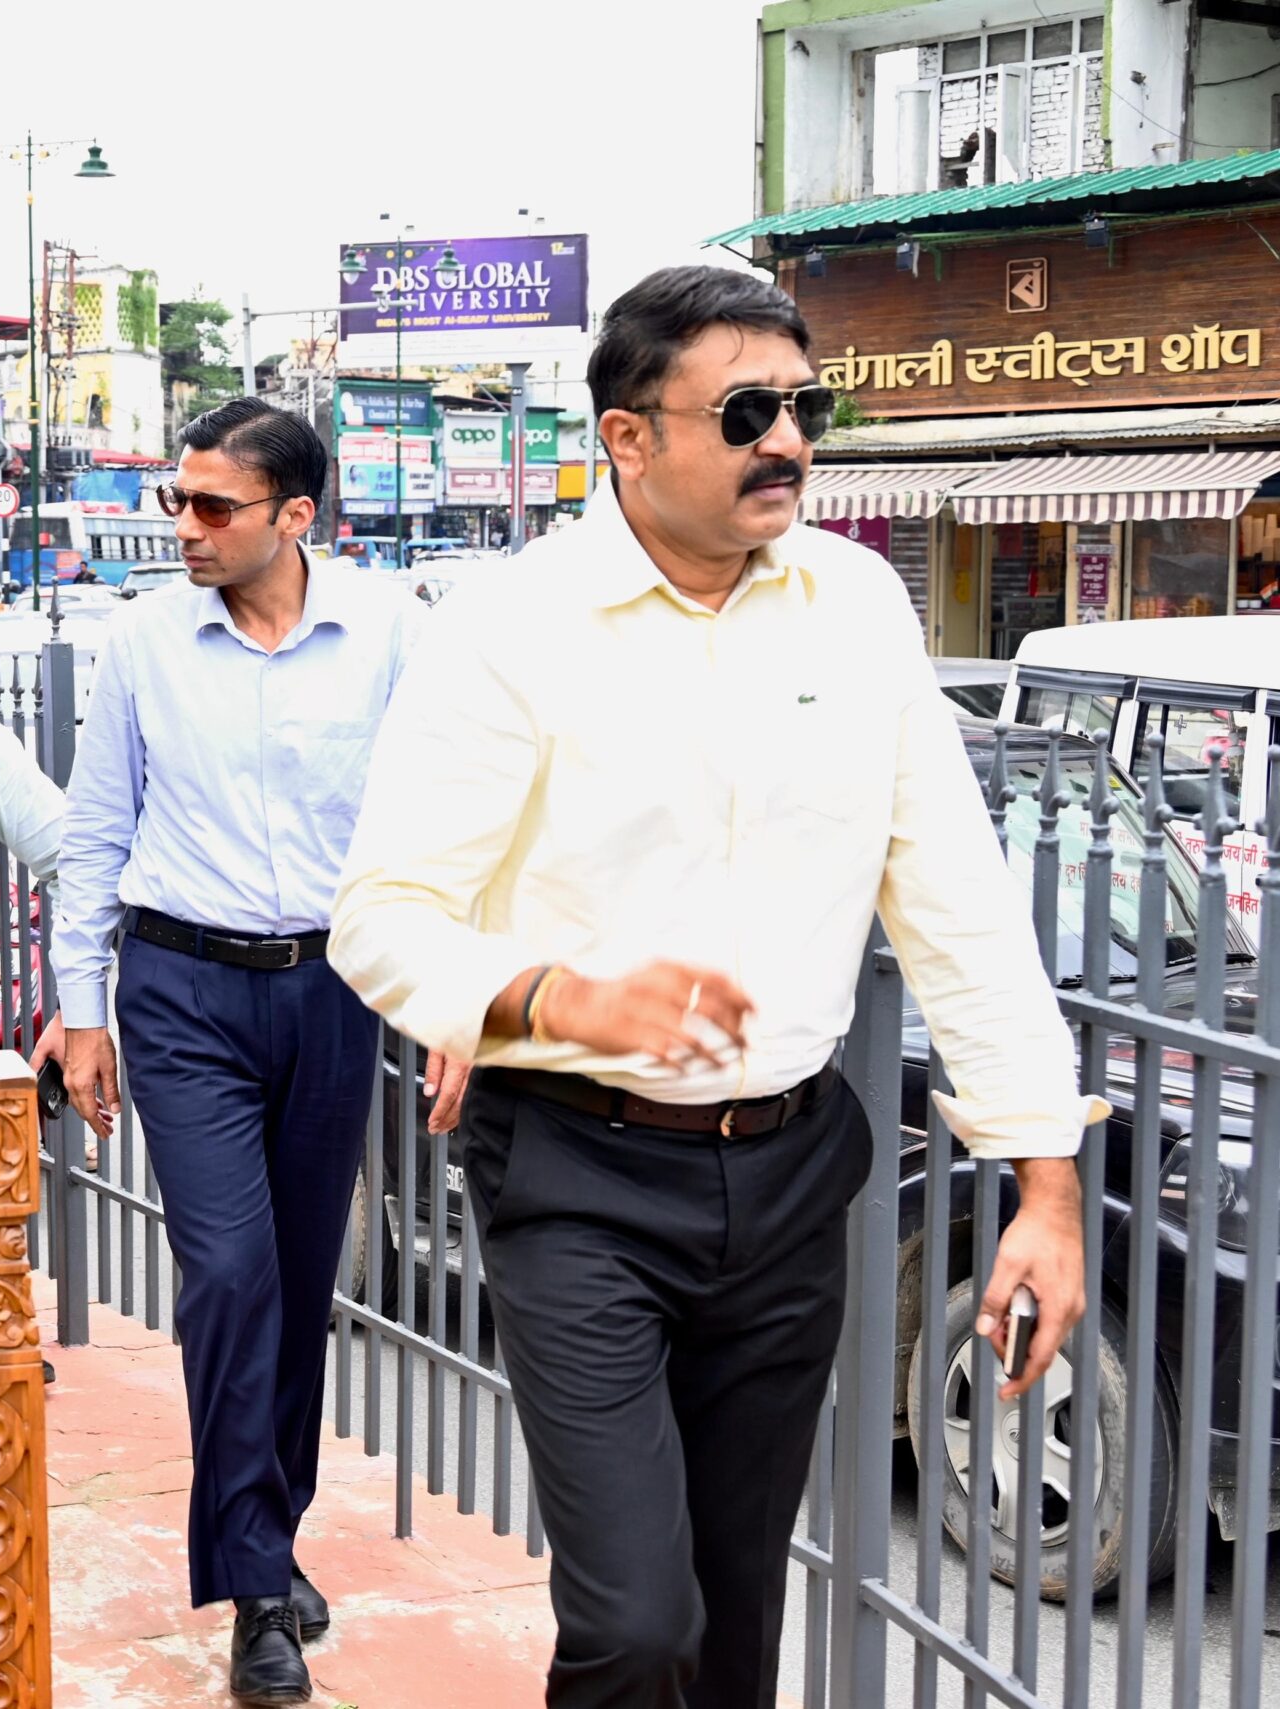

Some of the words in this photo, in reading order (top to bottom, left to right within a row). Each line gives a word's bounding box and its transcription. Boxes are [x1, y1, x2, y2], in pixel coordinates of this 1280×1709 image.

[376, 265, 429, 292] DBS
[376, 317, 411, 328] INDI'S
[414, 315, 441, 326] MOST
[492, 312, 551, 324] UNIVERSITY
[819, 339, 953, 391] बंगाली
[965, 331, 1145, 387] स्वीट्स
[1161, 323, 1261, 373] शॉप
[451, 428, 496, 444] oppo
[507, 429, 552, 446] po
[1185, 837, 1207, 855] तरु
